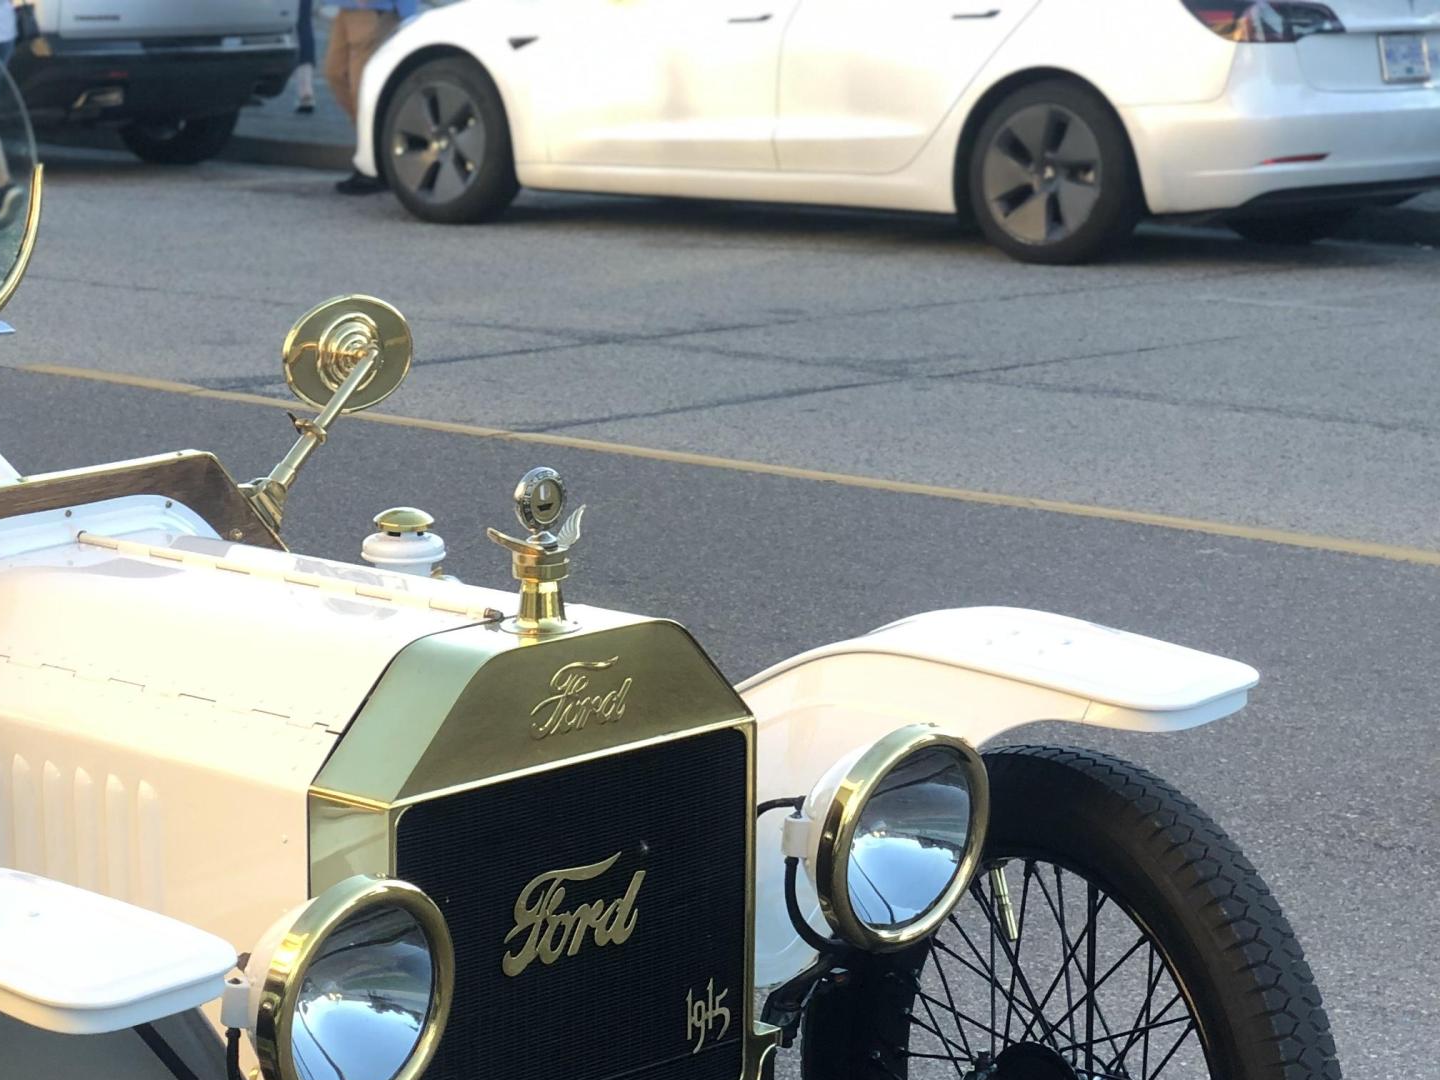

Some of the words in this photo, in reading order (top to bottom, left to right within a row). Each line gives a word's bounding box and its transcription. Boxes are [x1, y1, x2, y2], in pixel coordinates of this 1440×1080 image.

[530, 656, 633, 739] Ford
[502, 851, 646, 977] Ford
[685, 977, 730, 1054] 1915
